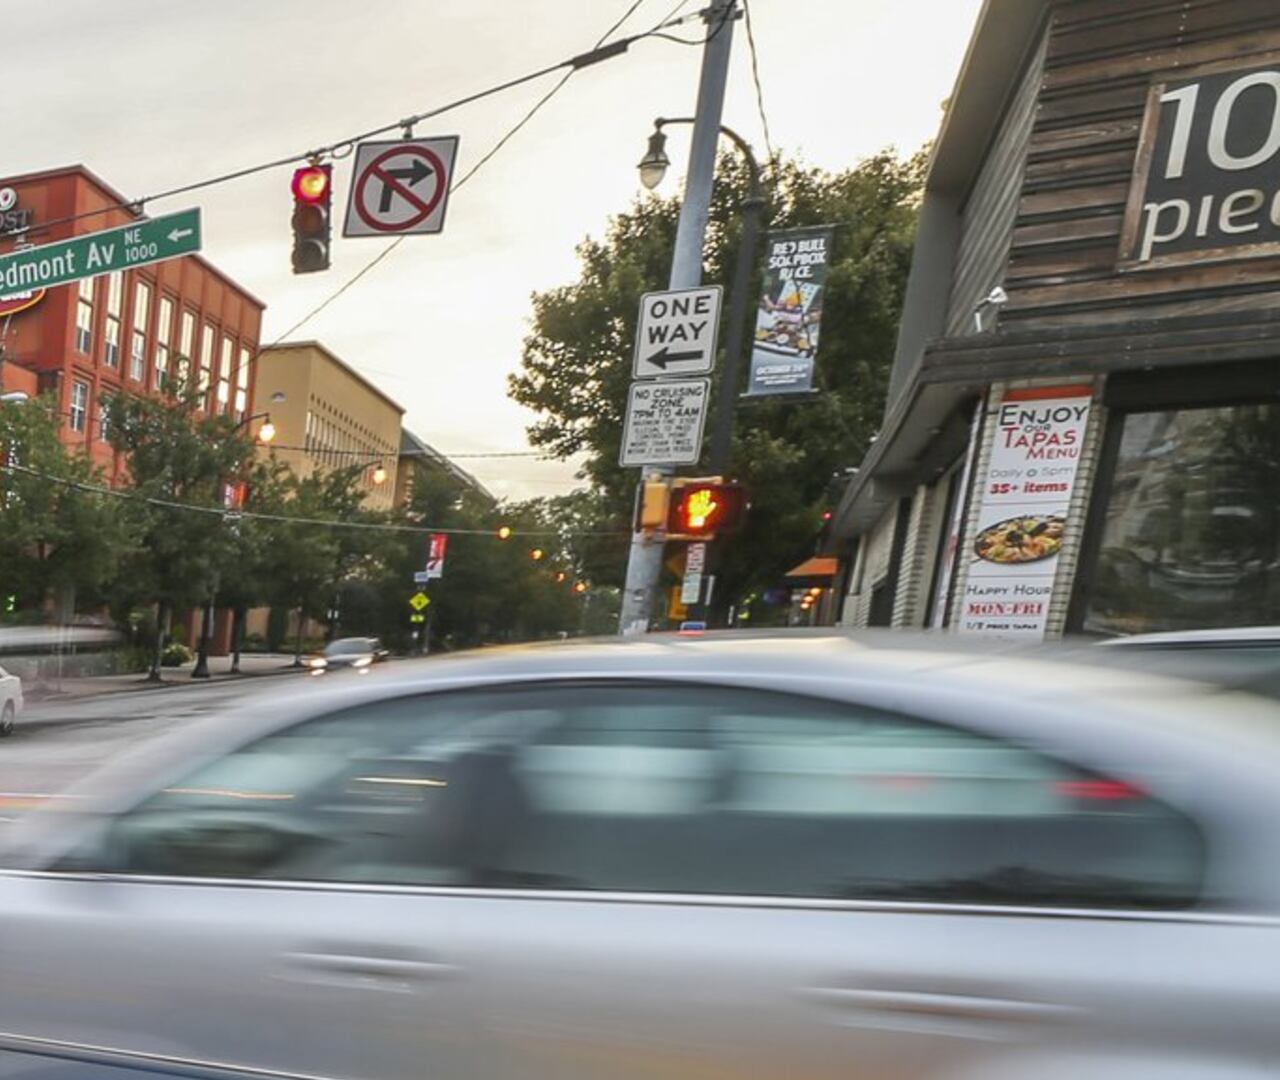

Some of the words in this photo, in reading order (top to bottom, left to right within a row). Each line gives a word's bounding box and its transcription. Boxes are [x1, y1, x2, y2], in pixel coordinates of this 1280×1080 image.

[1159, 71, 1280, 179] 10
[125, 228, 142, 246] NE
[86, 241, 116, 269] Av
[125, 243, 158, 263] 1000
[650, 295, 711, 319] ONE
[648, 320, 707, 344] WAY
[635, 389, 650, 399] NO
[653, 386, 702, 398] CRUISING
[650, 397, 685, 409] ZONE
[633, 410, 654, 419] 7PM
[658, 408, 671, 418] TO
[674, 407, 699, 417] 4AM
[999, 405, 1088, 427] ENJOY
[1024, 424, 1052, 433] OUR
[1002, 426, 1077, 448] TAPAS
[1026, 447, 1079, 460] MENU
[989, 483, 1019, 495] 35+
[1023, 481, 1068, 494] items
[968, 602, 1042, 615] MON-FRI
